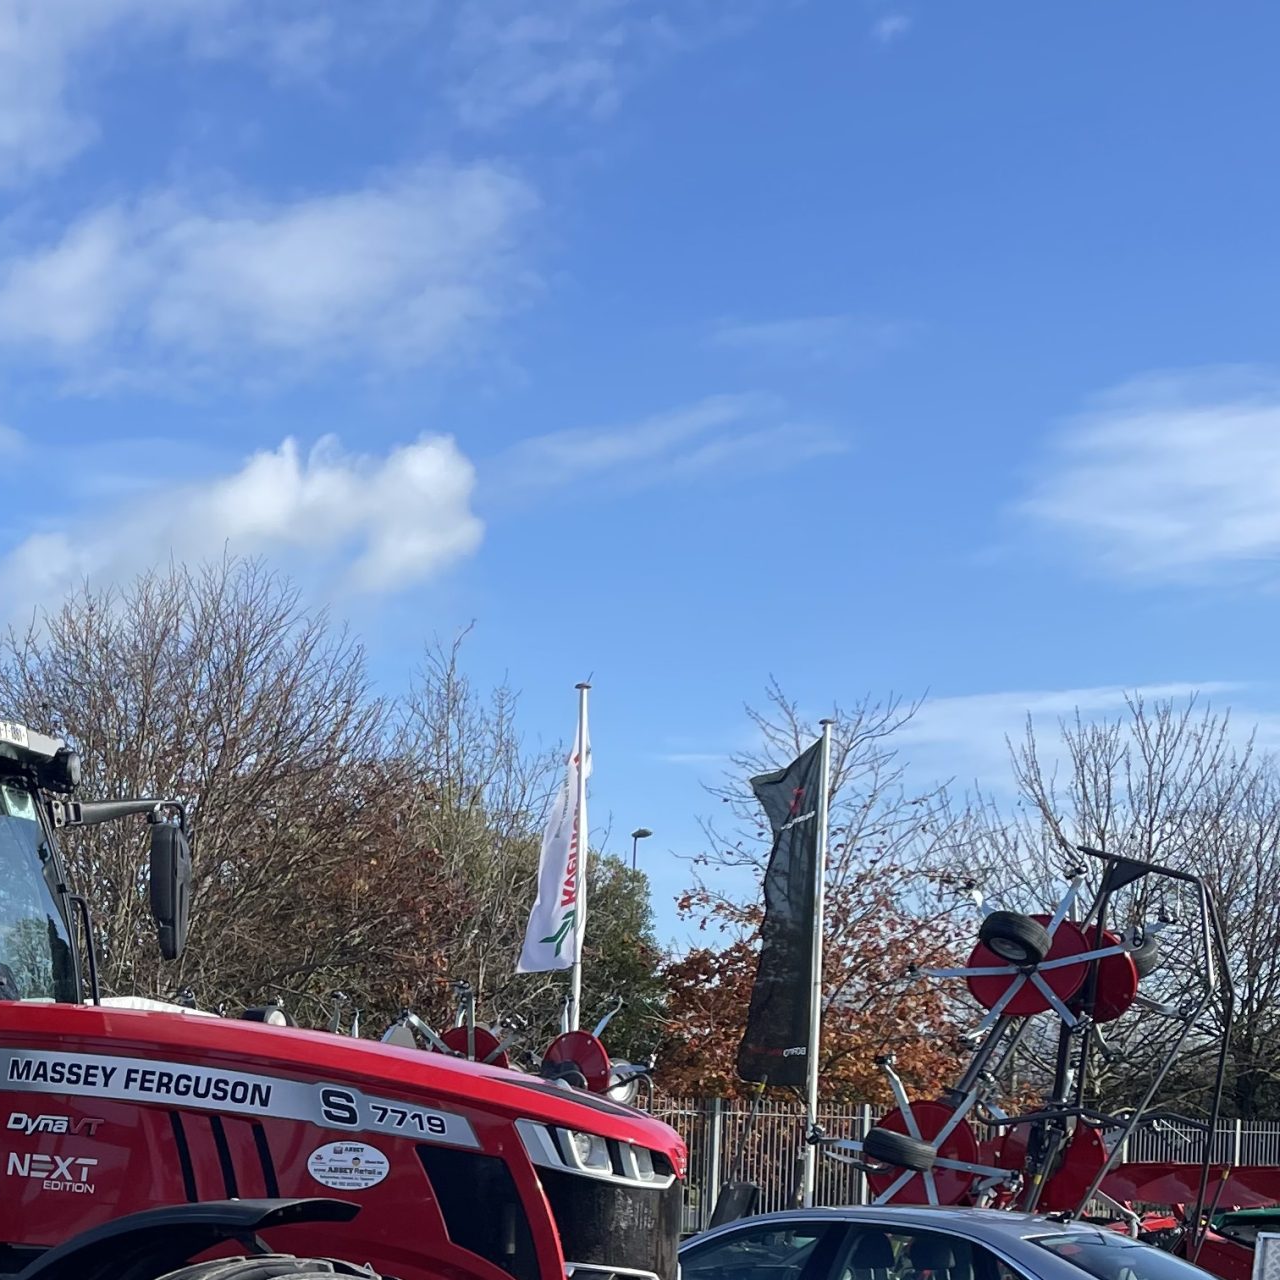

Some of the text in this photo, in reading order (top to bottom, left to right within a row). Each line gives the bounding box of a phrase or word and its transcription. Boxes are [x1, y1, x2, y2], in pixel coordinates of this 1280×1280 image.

[8, 1058, 447, 1135] MASSEY FERGUSON S 7719
[6, 1152, 99, 1182] NEXT
[42, 1179, 95, 1194] EDITION
